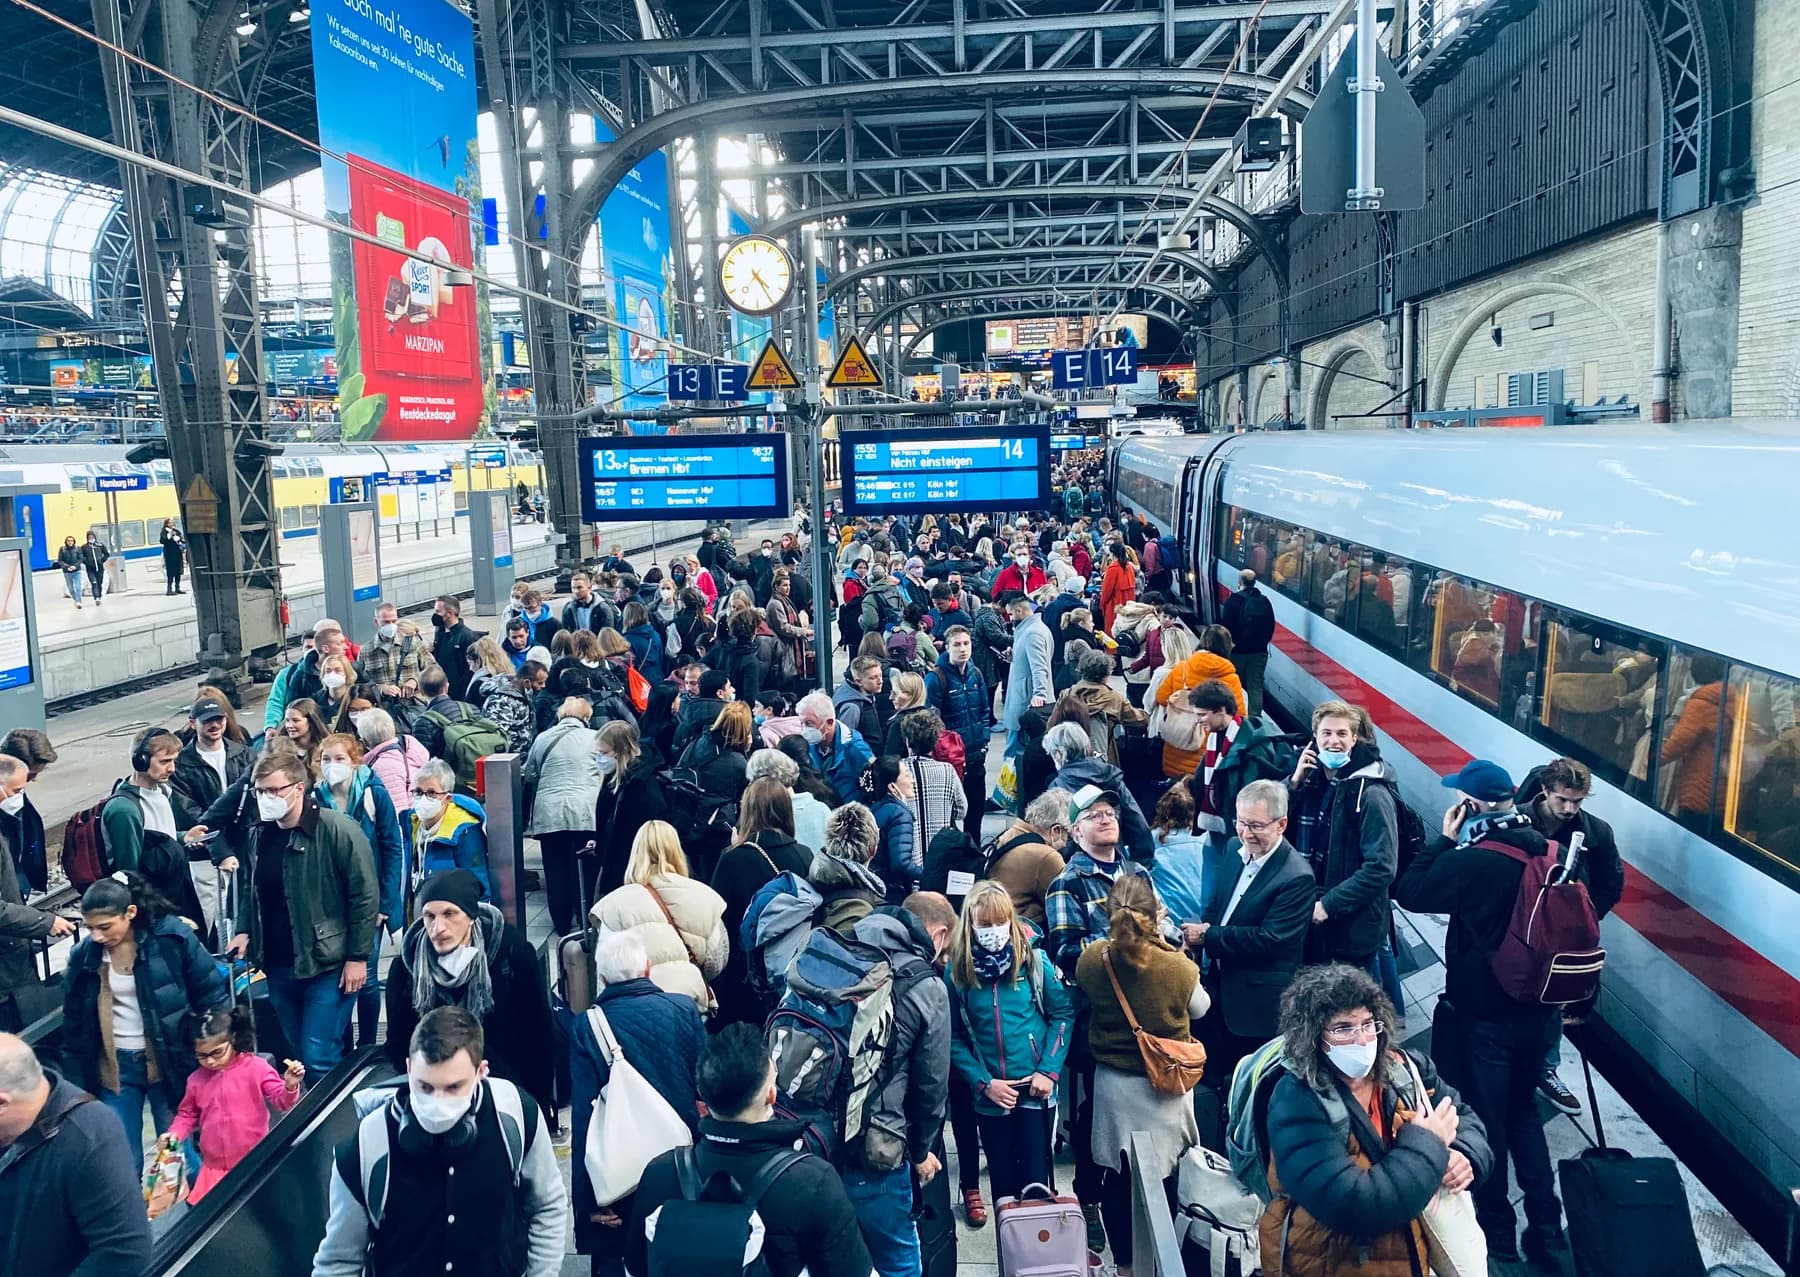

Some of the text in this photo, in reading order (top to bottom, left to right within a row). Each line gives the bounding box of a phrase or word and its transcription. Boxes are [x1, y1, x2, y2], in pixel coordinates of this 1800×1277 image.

[327, 13, 340, 31] Wir
[340, 24, 360, 42] setzen
[360, 36, 370, 50] uns
[371, 42, 380, 55] seit
[381, 45, 390, 60] 30
[390, 52, 406, 70] Jahren
[376, 10, 396, 34] mal
[414, 34, 435, 58] gute
[436, 42, 466, 80] Sache.
[328, 33, 380, 72] Kakaoanbau ein.
[412, 282, 430, 295] SPORT
[406, 334, 444, 354] MARZIPAN
[1065, 354, 1084, 382] E
[1104, 350, 1132, 377] 14
[678, 368, 700, 392] 13
[718, 368, 734, 394] E
[400, 406, 456, 424] #entdeckedasgut
[1056, 412, 1063, 420] D
[752, 446, 773, 456] 16:37
[1002, 439, 1024, 460] 14
[593, 450, 616, 470] 13
[891, 456, 972, 469] Nicht einsteigen
[630, 463, 690, 474] Bremen Hbf
[100, 478, 138, 488] Hamburg Hbf
[928, 480, 944, 488] Köln
[946, 480, 958, 488] Hbf
[701, 486, 714, 494] Hbf
[928, 490, 944, 498] Köln
[696, 496, 708, 504] Hbf
